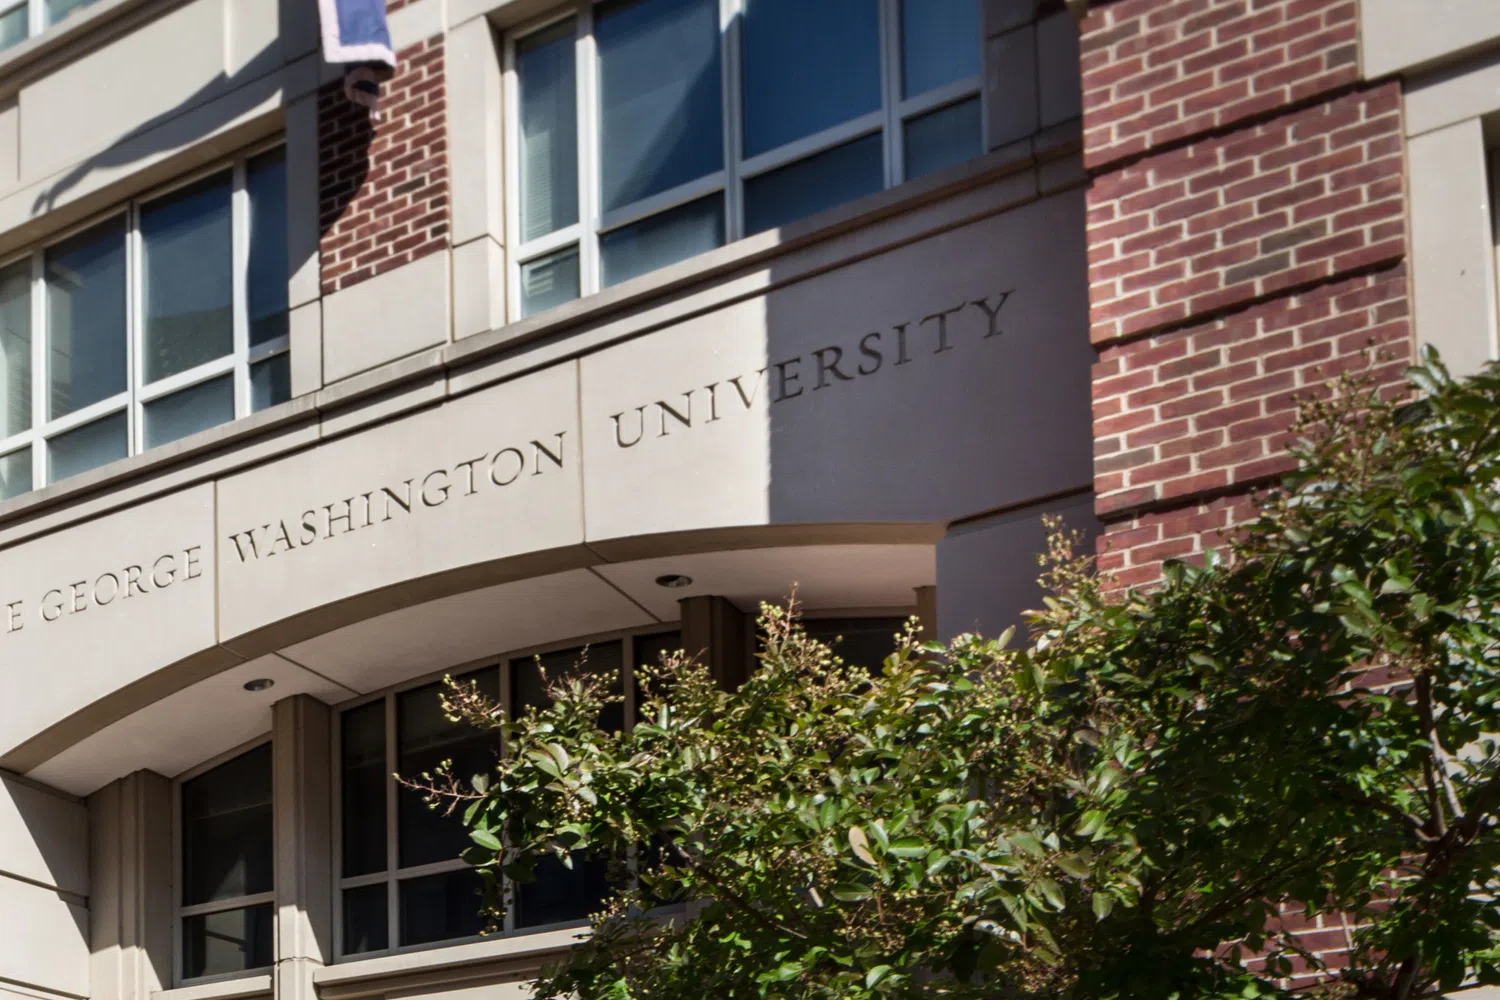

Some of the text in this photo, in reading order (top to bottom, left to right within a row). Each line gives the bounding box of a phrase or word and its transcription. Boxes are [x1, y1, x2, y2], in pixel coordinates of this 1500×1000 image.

[40, 546, 202, 622] GEORGE
[229, 431, 567, 563] WASHINGTON
[609, 289, 1016, 448] UNIVERSITY
